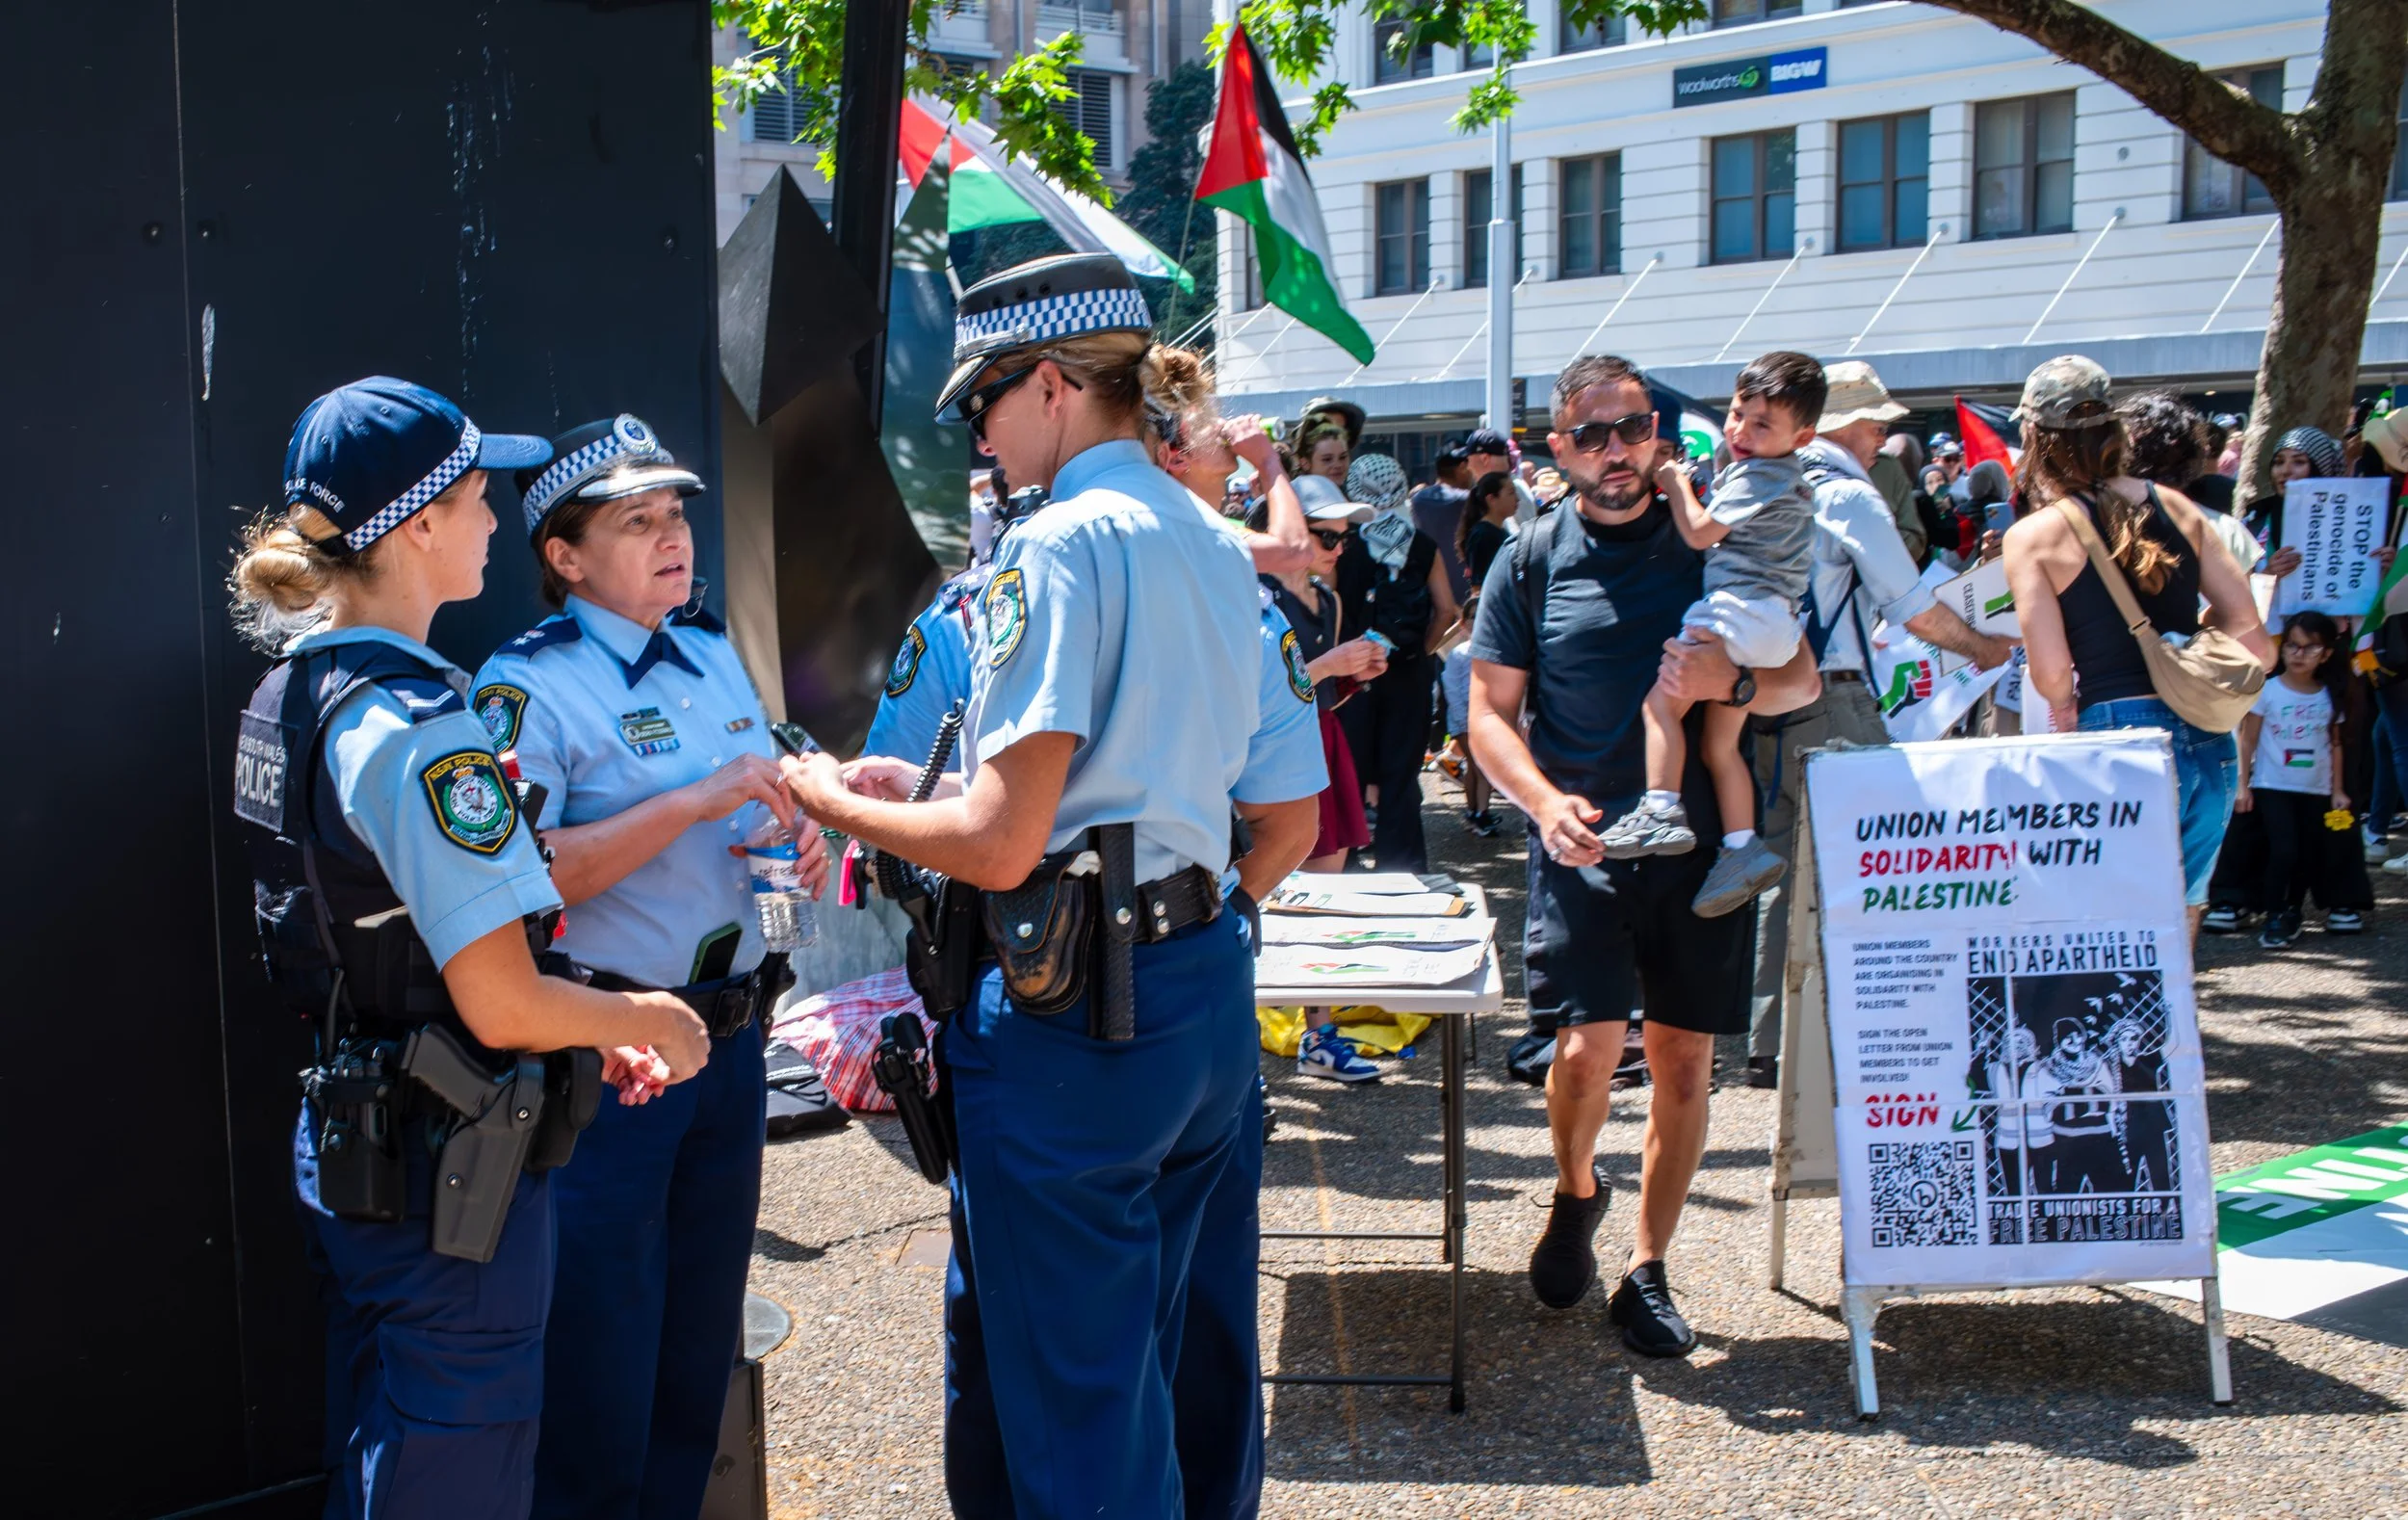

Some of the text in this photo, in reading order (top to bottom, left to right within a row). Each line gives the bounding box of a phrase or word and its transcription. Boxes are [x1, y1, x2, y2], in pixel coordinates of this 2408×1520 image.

[1678, 74, 1740, 94] woolworths
[309, 481, 345, 512] FORCE
[2301, 491, 2328, 601] Palestinians
[2324, 492, 2347, 600] genocide of
[2348, 505, 2372, 589] STOP the
[235, 752, 282, 807] POLICE
[1856, 800, 2143, 842] UNION MEMBERS IN
[1859, 838, 2103, 878] SOLIDARITY WITH
[1862, 876, 2019, 913] PALESTINE
[1852, 939, 1931, 952] UNION MEMBERS
[1967, 930, 2156, 949] WORKERS UNITED TO
[1854, 953, 1958, 966] AROUND THE COUNTRY
[2026, 944, 2158, 973] APARTHEID
[1854, 968, 1945, 981] ARE ORGANISING IN
[1855, 983, 1936, 995] SOLIDARITY WITH
[1857, 1028, 1928, 1039] SIGN THE OPEN
[1858, 1041, 1953, 1054] LETTER FROM UNION
[1860, 1057, 1940, 1068] MEMBERS TO GET
[1865, 1091, 1940, 1128] SIGN
[1987, 1197, 2178, 1219] TRADE UNIONISTS FOR A
[1988, 1214, 2182, 1245] FREE PALESTINE
